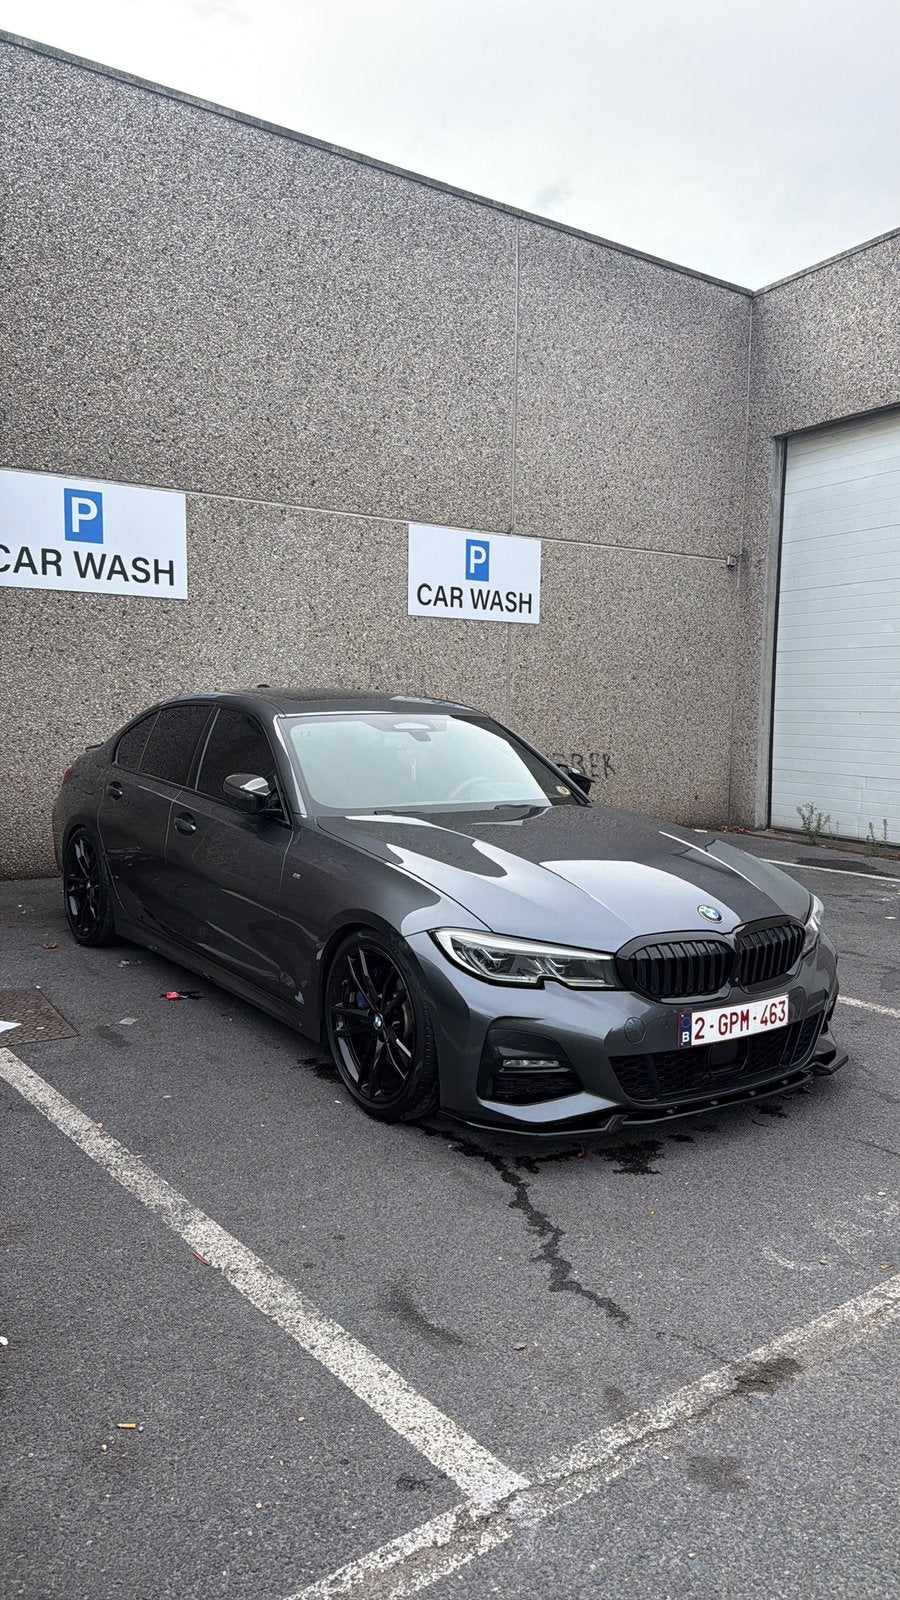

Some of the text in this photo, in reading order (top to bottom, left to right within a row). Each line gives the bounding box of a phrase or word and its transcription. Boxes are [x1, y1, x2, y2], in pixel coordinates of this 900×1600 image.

[71, 496, 98, 533] P
[73, 550, 175, 587] WASH
[469, 545, 487, 574] P
[416, 583, 533, 614] CAR WASH
[682, 1031, 690, 1043] B
